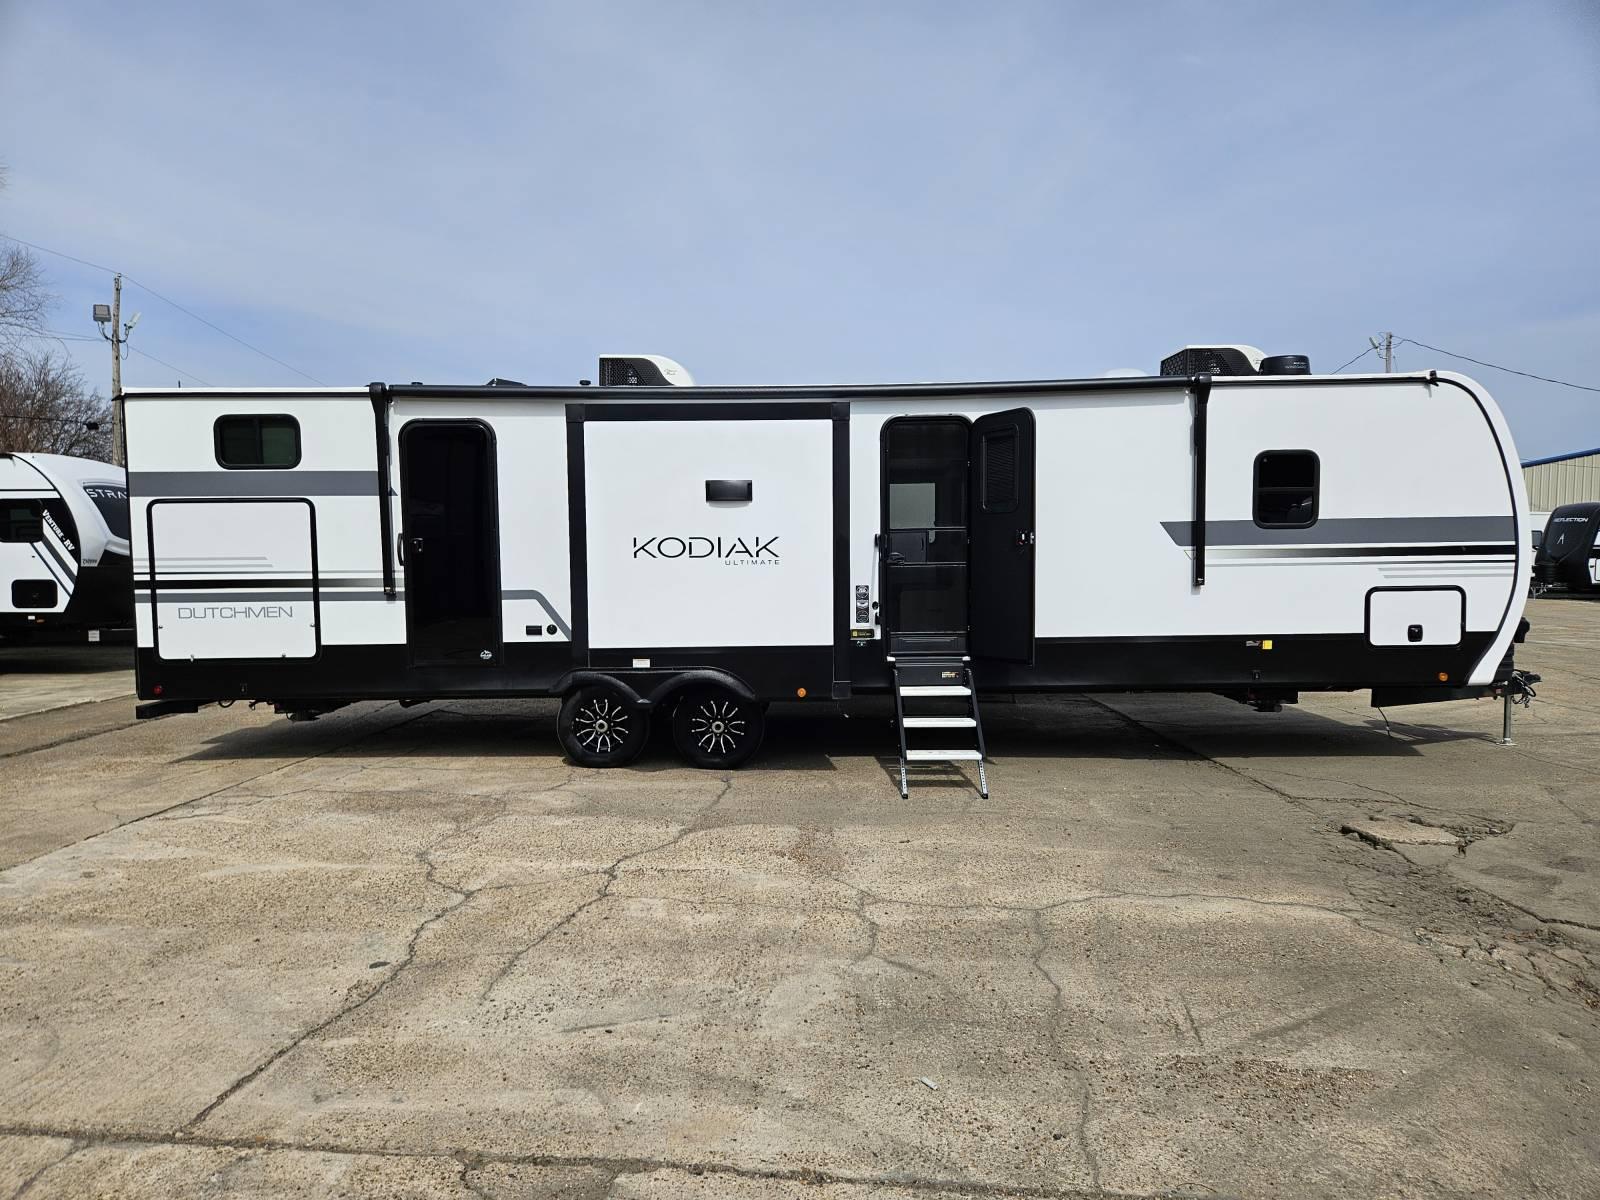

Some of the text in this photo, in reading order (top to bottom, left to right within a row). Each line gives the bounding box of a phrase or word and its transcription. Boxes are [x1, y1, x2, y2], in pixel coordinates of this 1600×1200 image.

[86, 488, 127, 499] STRA
[42, 509, 65, 539] VENTURE
[63, 539, 76, 552] RV
[633, 536, 780, 559] KODIAK
[178, 606, 293, 620] DUTCHMEN
